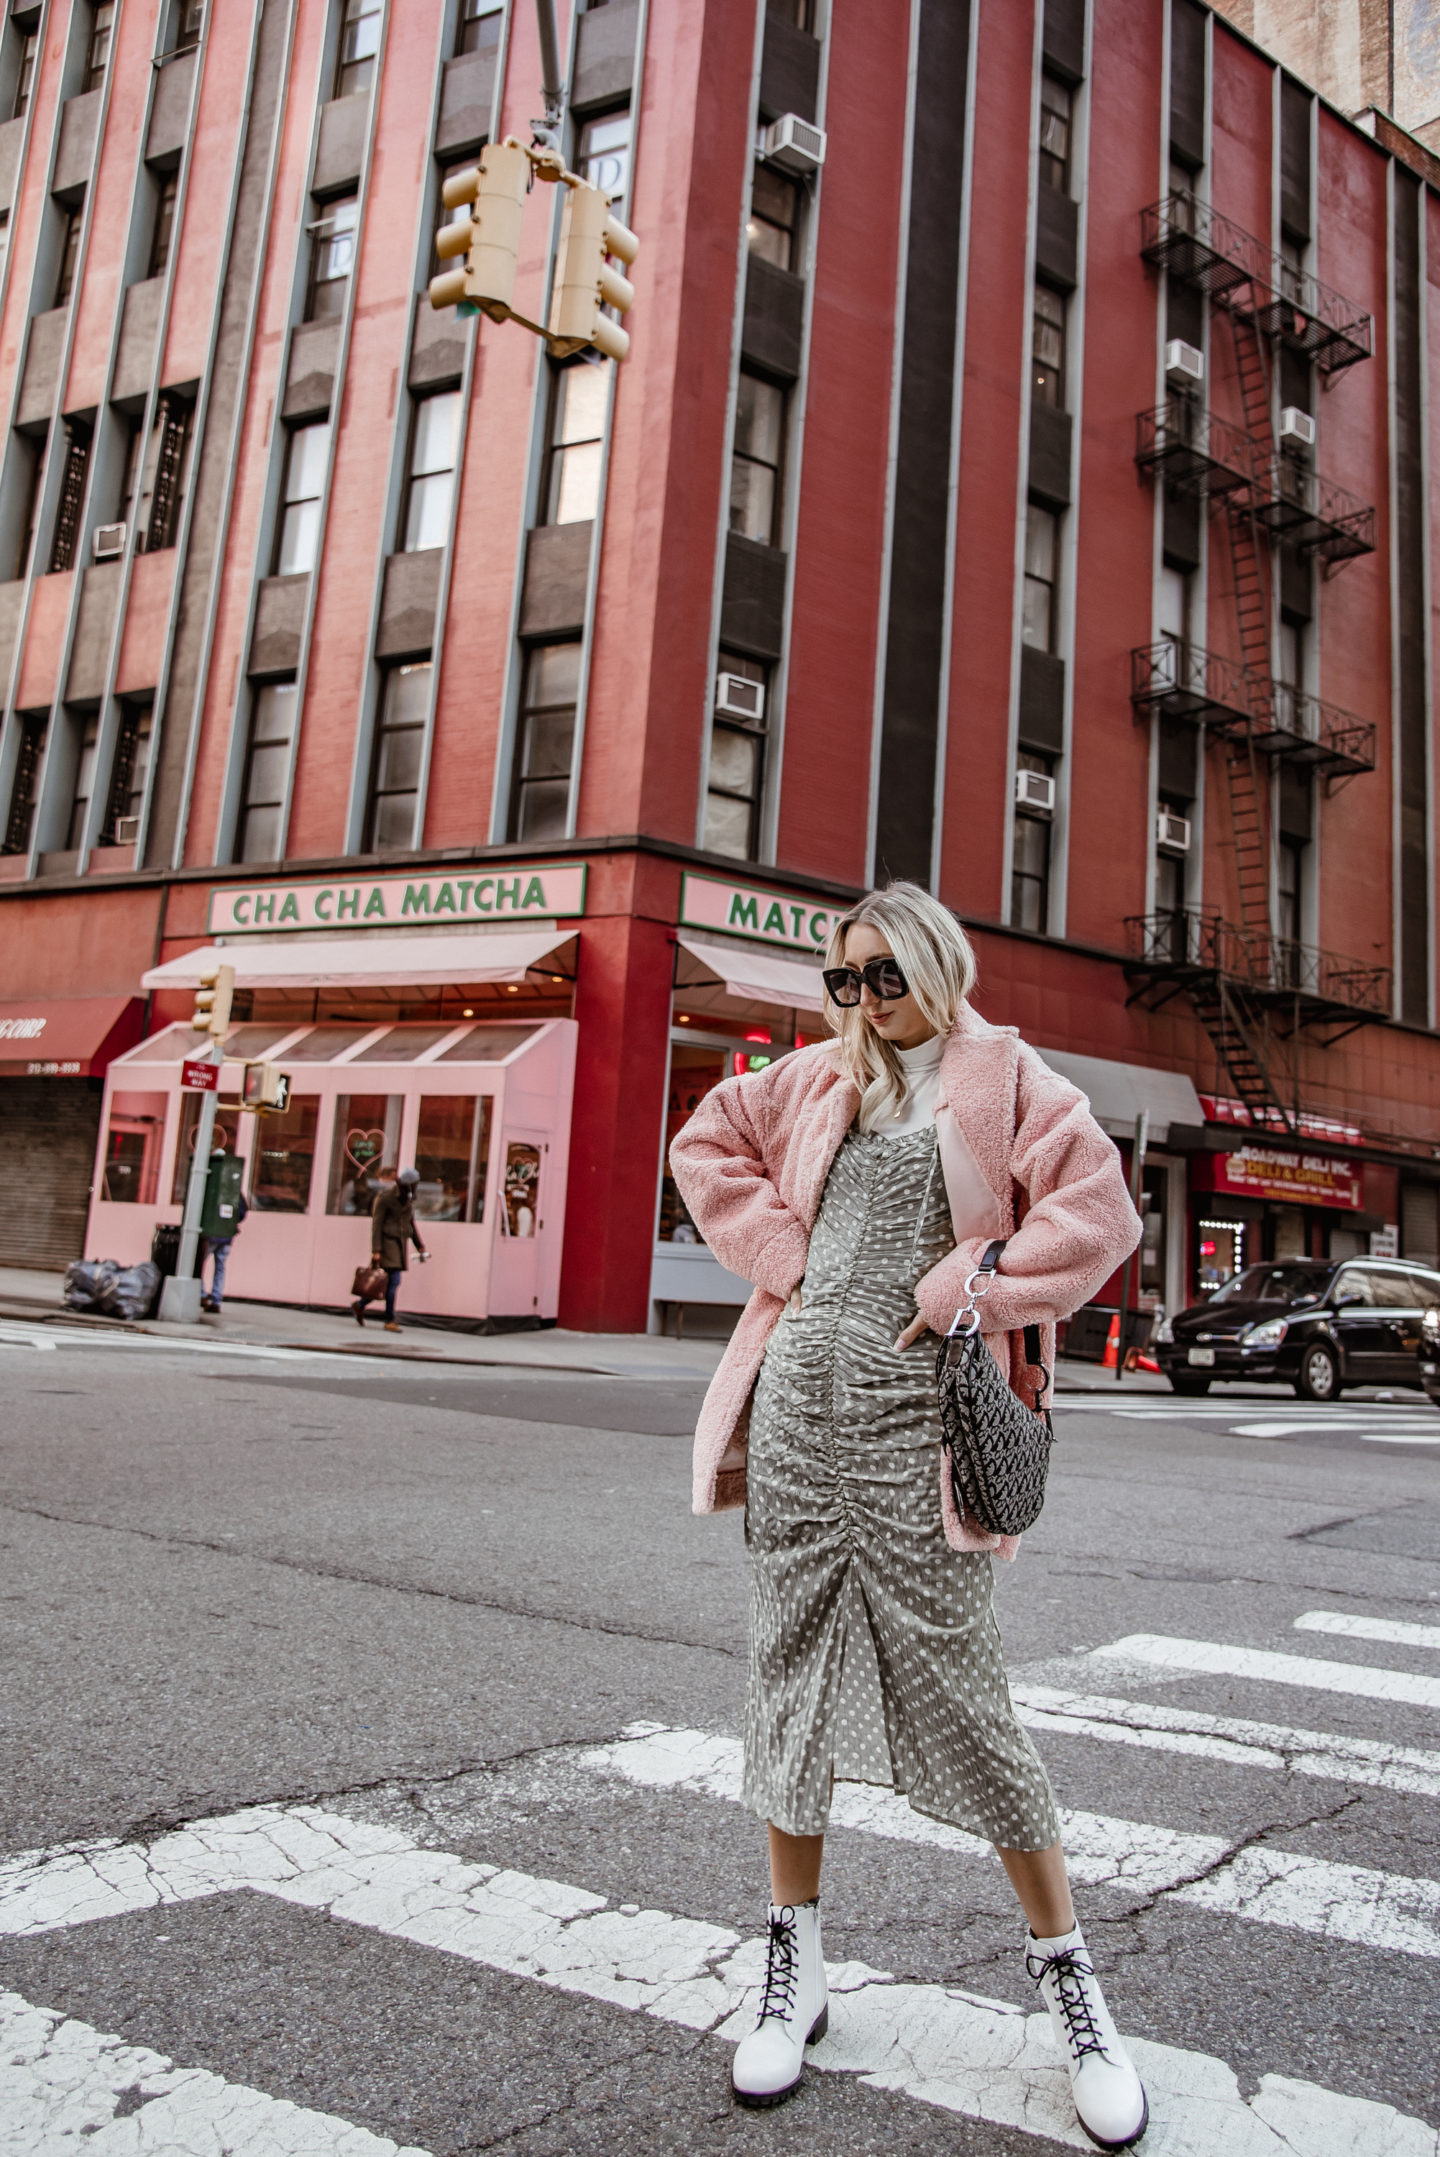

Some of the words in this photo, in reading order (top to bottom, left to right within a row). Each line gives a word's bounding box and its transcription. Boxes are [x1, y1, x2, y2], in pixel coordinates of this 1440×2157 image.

[232, 892, 299, 924] CHA
[313, 887, 387, 920] CHA
[400, 876, 546, 915] MATCHA
[728, 893, 840, 944] MATC
